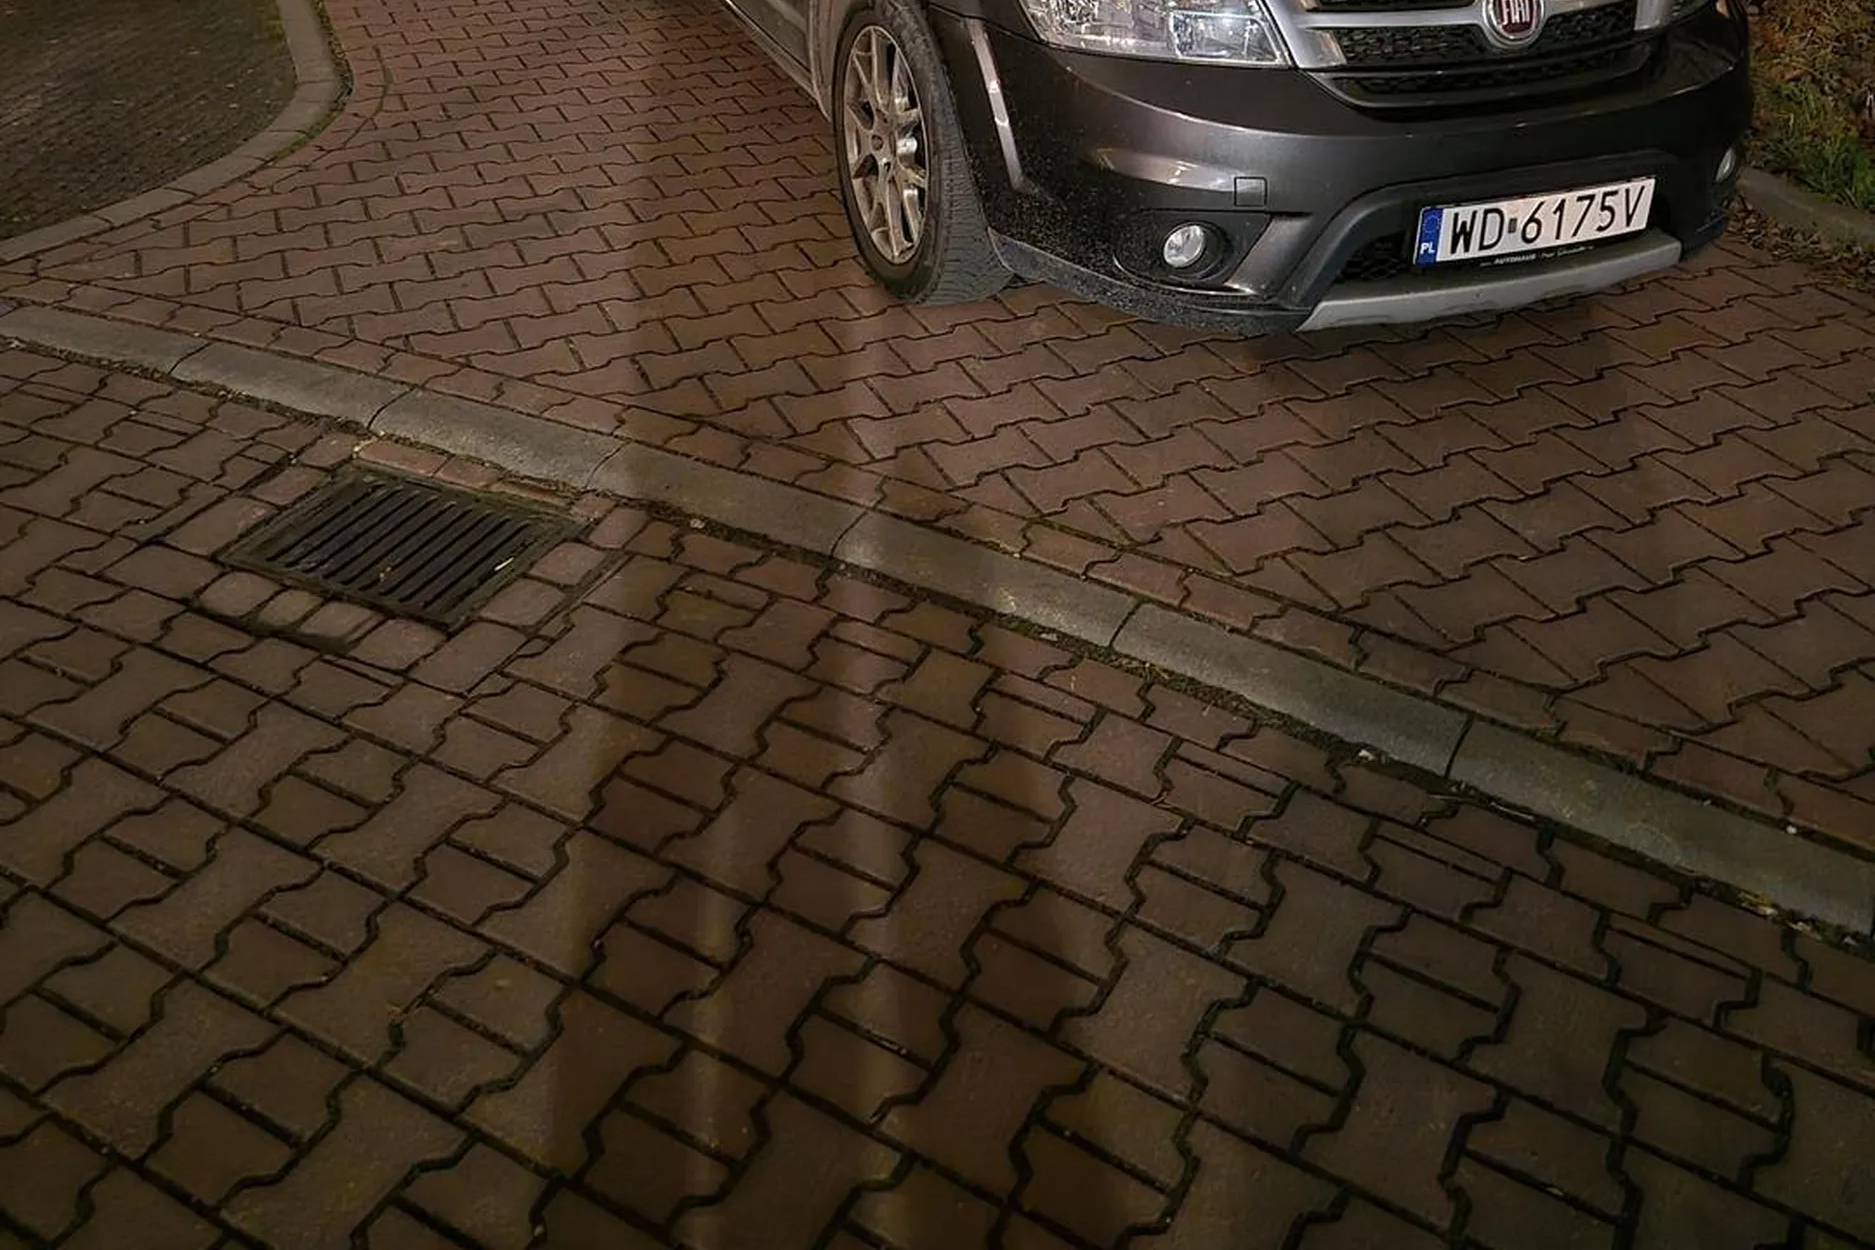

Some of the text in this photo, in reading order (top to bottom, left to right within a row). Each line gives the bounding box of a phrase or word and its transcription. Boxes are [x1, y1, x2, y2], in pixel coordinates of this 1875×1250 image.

[1451, 186, 1645, 254] WD 6175V
[1420, 242, 1435, 255] PL
